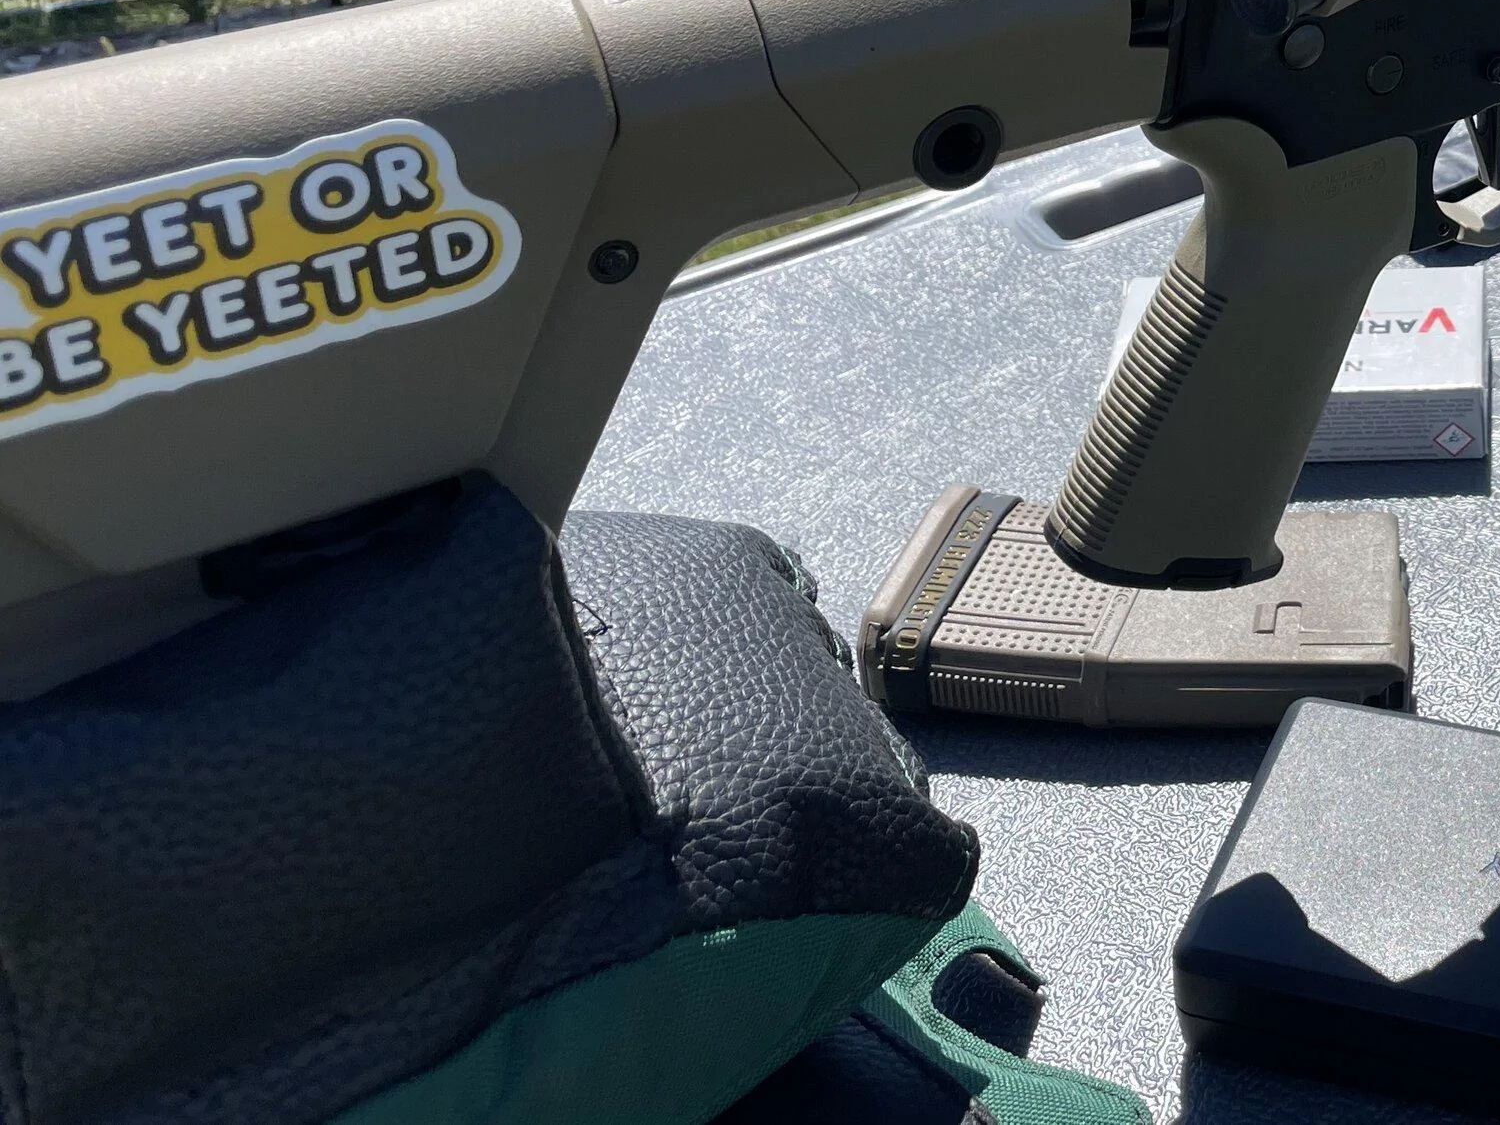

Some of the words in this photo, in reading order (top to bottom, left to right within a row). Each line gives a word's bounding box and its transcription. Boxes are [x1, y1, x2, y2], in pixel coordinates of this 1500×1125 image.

[9, 181, 261, 301] YEET
[297, 144, 432, 227] OR
[0, 318, 106, 403] BE
[130, 218, 491, 359] YEETED
